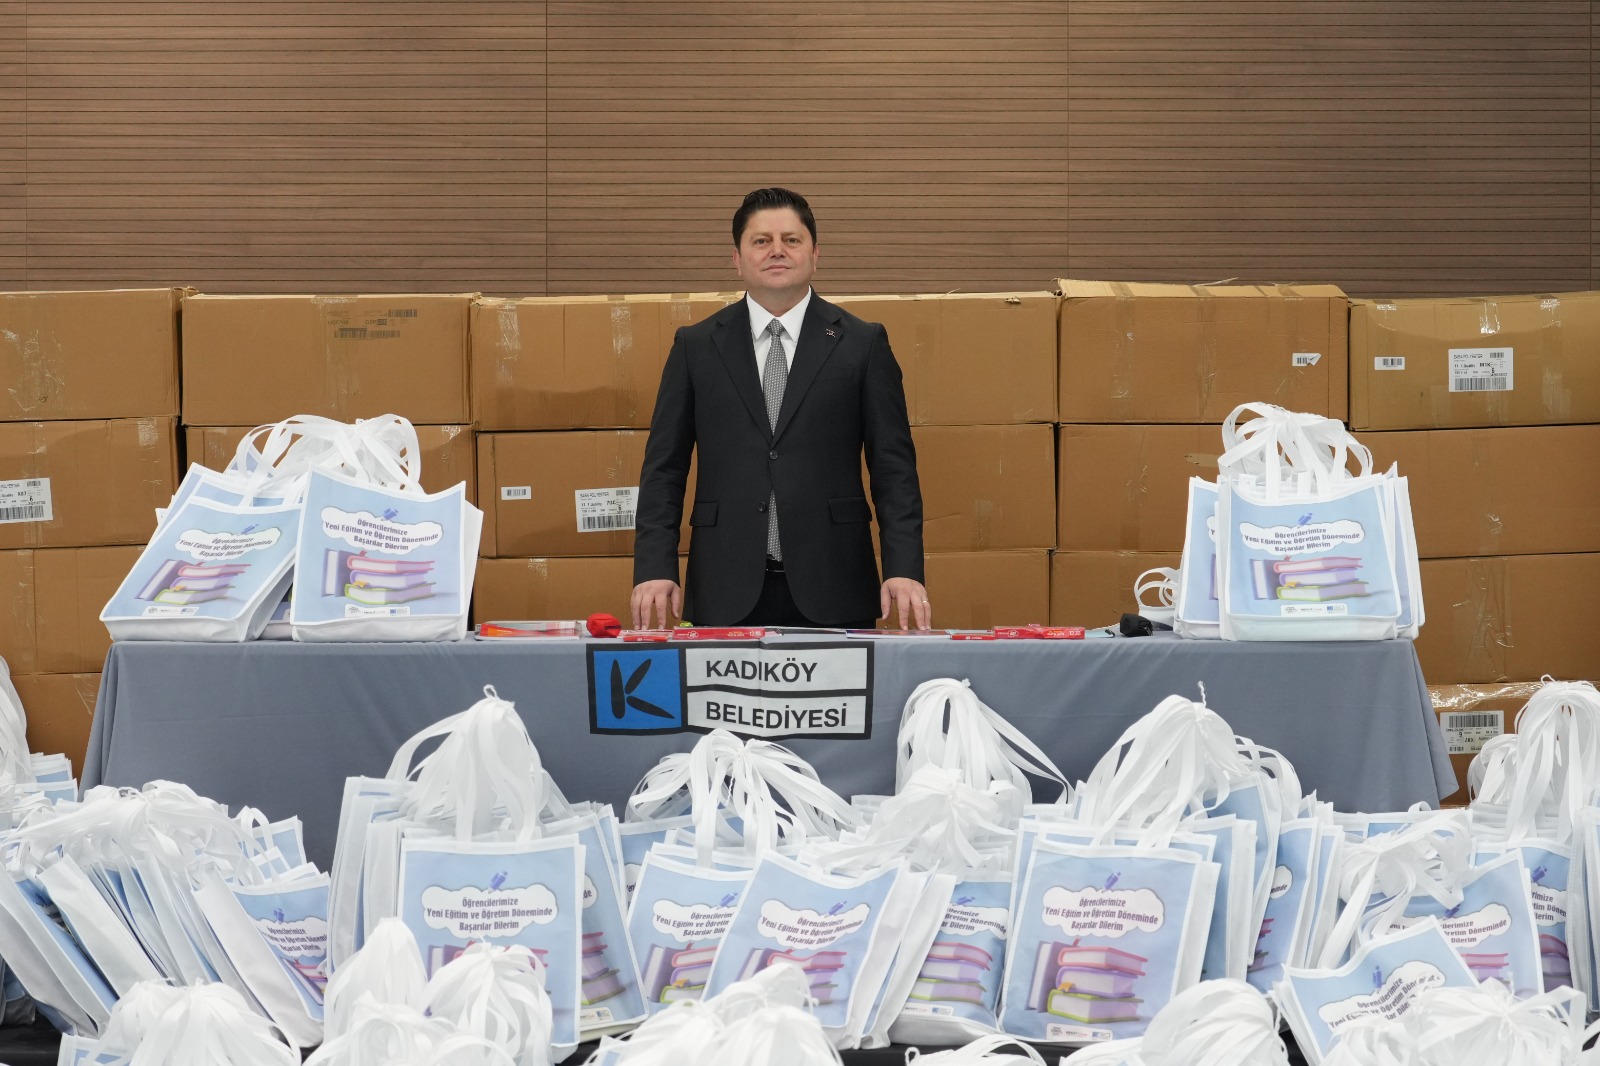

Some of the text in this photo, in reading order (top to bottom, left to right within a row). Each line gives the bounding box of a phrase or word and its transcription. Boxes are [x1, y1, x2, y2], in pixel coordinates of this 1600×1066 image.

[325, 522, 340, 531] Yeni
[341, 525, 363, 534] Eğitim
[374, 530, 400, 543] Öğretim
[401, 533, 439, 543] Döneminde
[357, 518, 408, 536] Öğrencilerimize
[1244, 535, 1259, 543] Yeni
[705, 657, 818, 683] KADIKÖY
[705, 701, 848, 729] BELEDİYESİ
[462, 897, 519, 908] Öğrencilerimize
[1079, 897, 1126, 908] Öğrencilerimize
[1531, 891, 1554, 902] rimize
[427, 908, 553, 920] Yeni Eğitim ve Öğretim Döneminde
[656, 914, 672, 926] Yeni
[672, 920, 694, 929] Eğitim
[1045, 907, 1060, 916] Yeni
[1061, 909, 1082, 919] Eğitim
[1091, 908, 1116, 919] Öğretim
[1117, 910, 1159, 925] Döneminde
[459, 921, 519, 934] Başarılar Dilerim
[761, 916, 777, 929] Yeni
[777, 923, 799, 934] Eğitim
[1099, 921, 1124, 931] Dilerim
[1468, 919, 1507, 935] Döneminde
